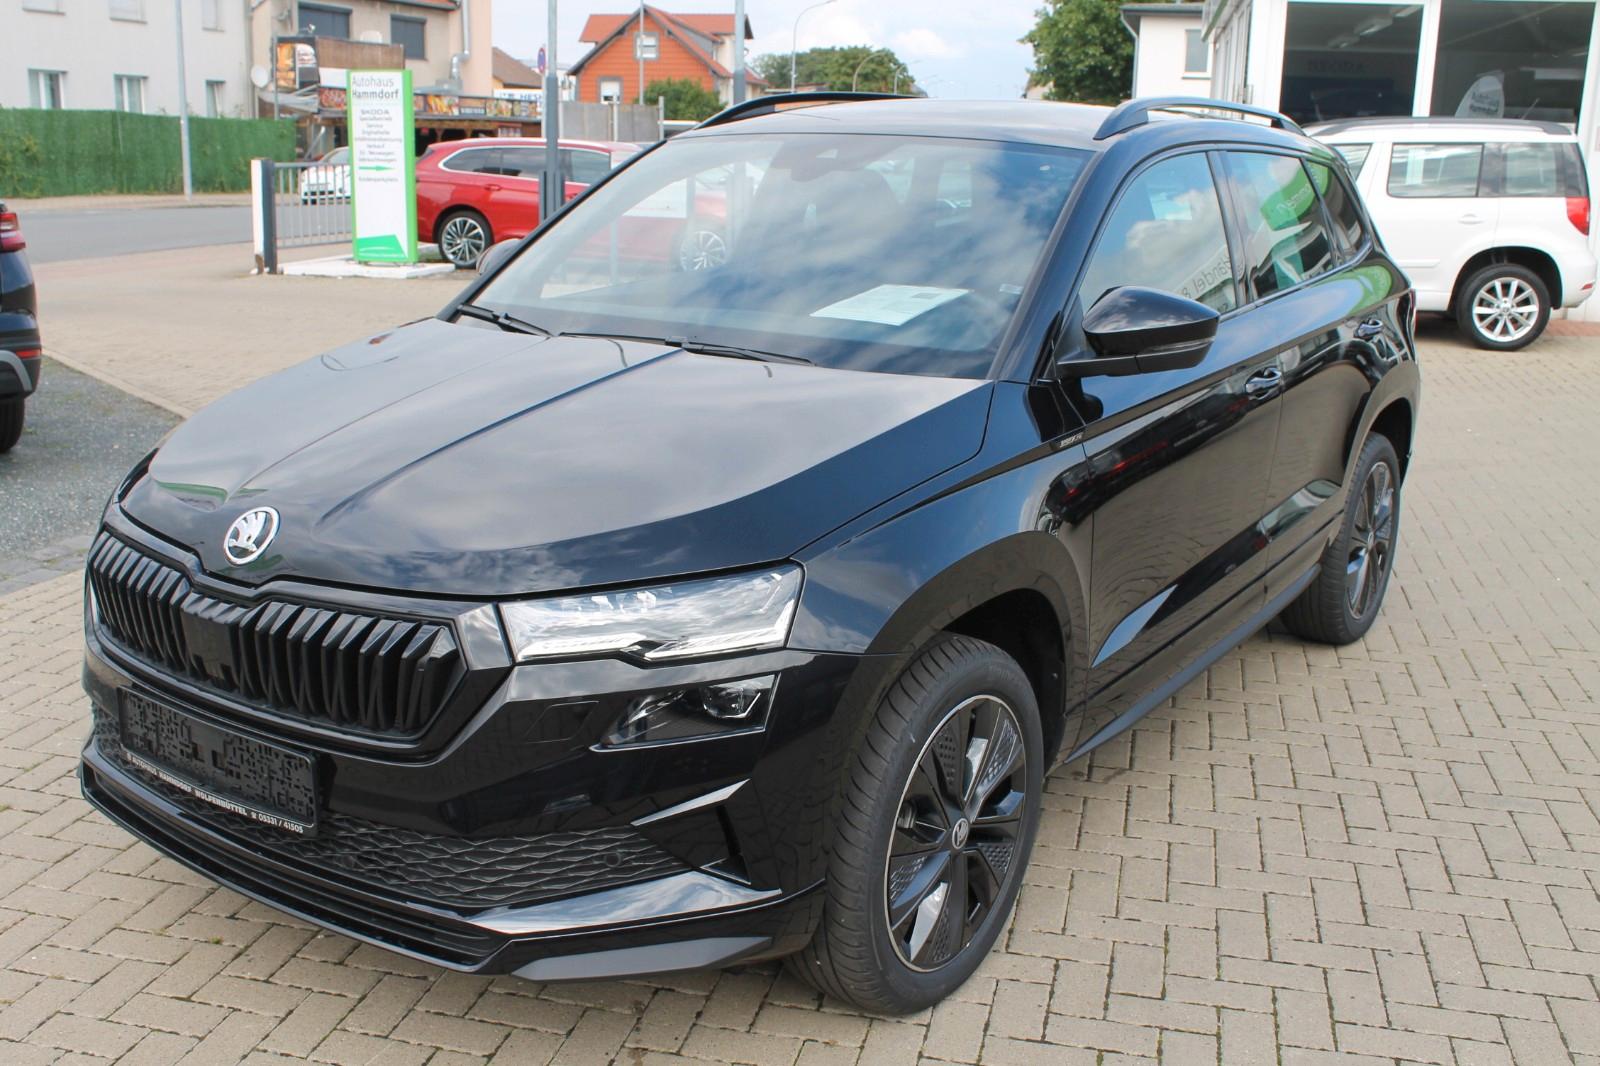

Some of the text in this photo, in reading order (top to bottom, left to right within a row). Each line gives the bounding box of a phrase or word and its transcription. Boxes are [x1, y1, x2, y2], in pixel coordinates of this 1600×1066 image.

[352, 75, 394, 88] Autohaus
[352, 88, 400, 99] Hammdorf
[195, 789, 248, 817] WOLFENBÜTTEL
[283, 819, 304, 835] 41505
